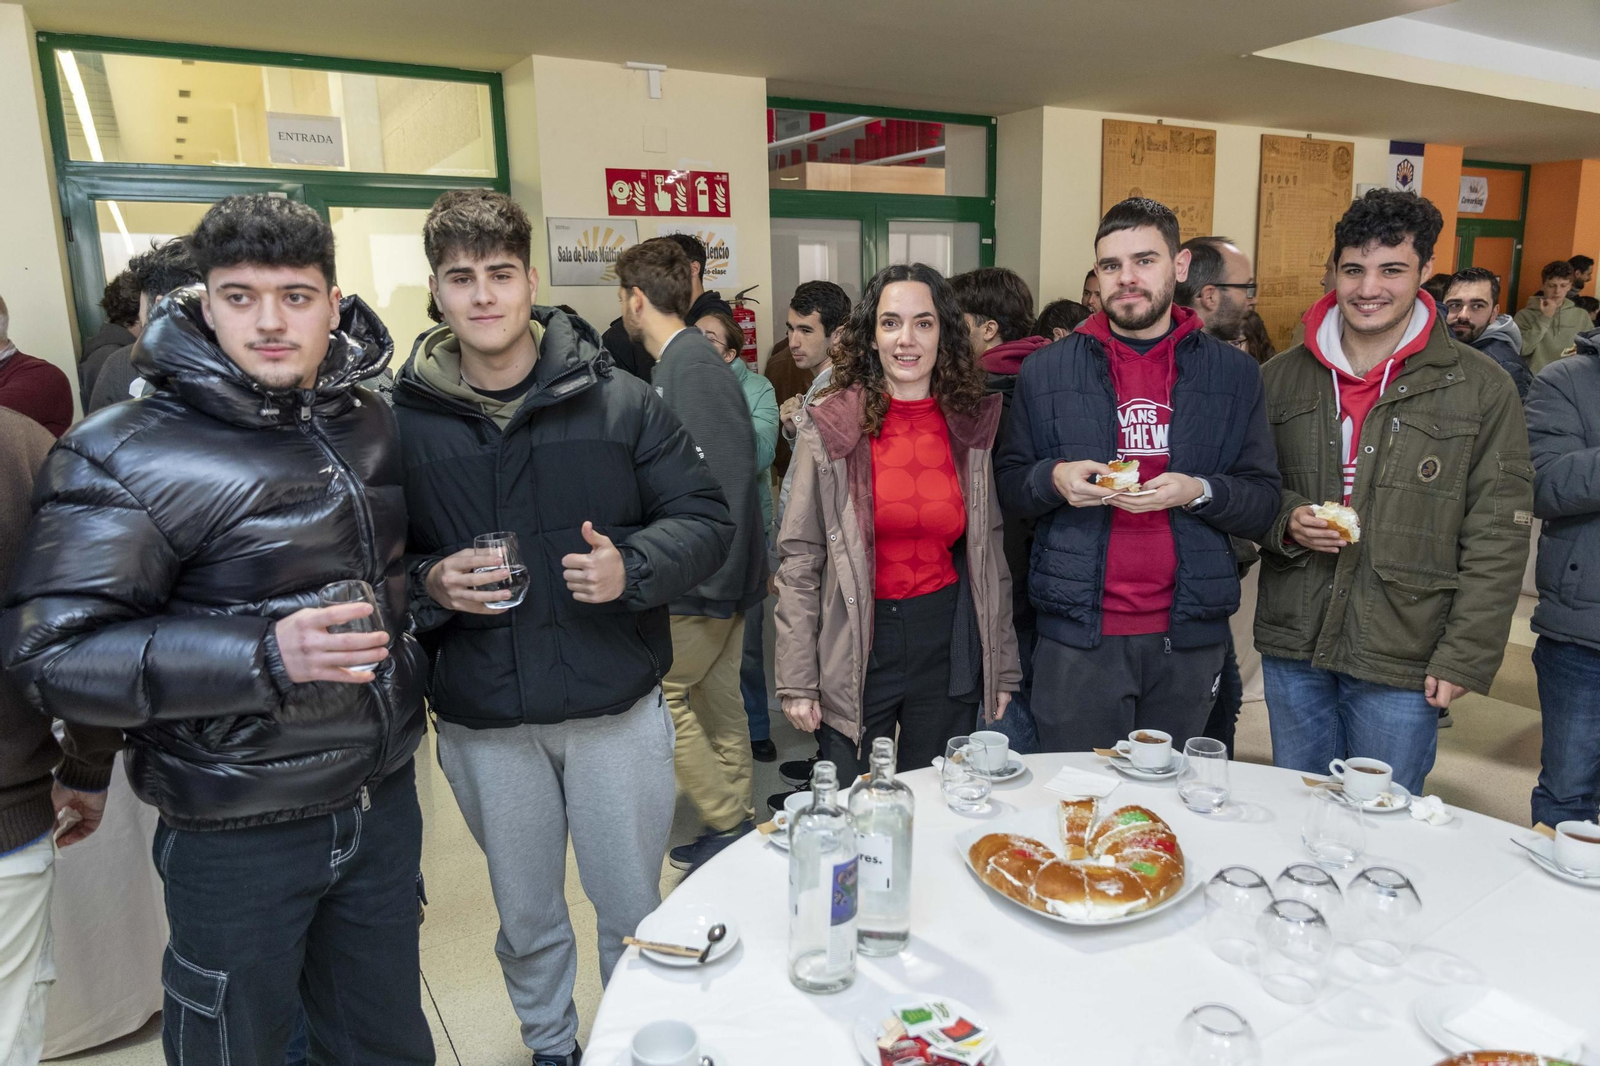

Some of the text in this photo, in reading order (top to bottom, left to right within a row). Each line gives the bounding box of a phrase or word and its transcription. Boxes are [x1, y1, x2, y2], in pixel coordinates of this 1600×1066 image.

[278, 131, 334, 144] ENTRADA
[557, 245, 573, 263] Sala
[573, 246, 582, 263] de
[582, 245, 598, 263] Usos
[704, 241, 730, 260] lencio
[1117, 404, 1158, 428] VANS
[1121, 424, 1151, 449] THE
[859, 853, 882, 865] res.
